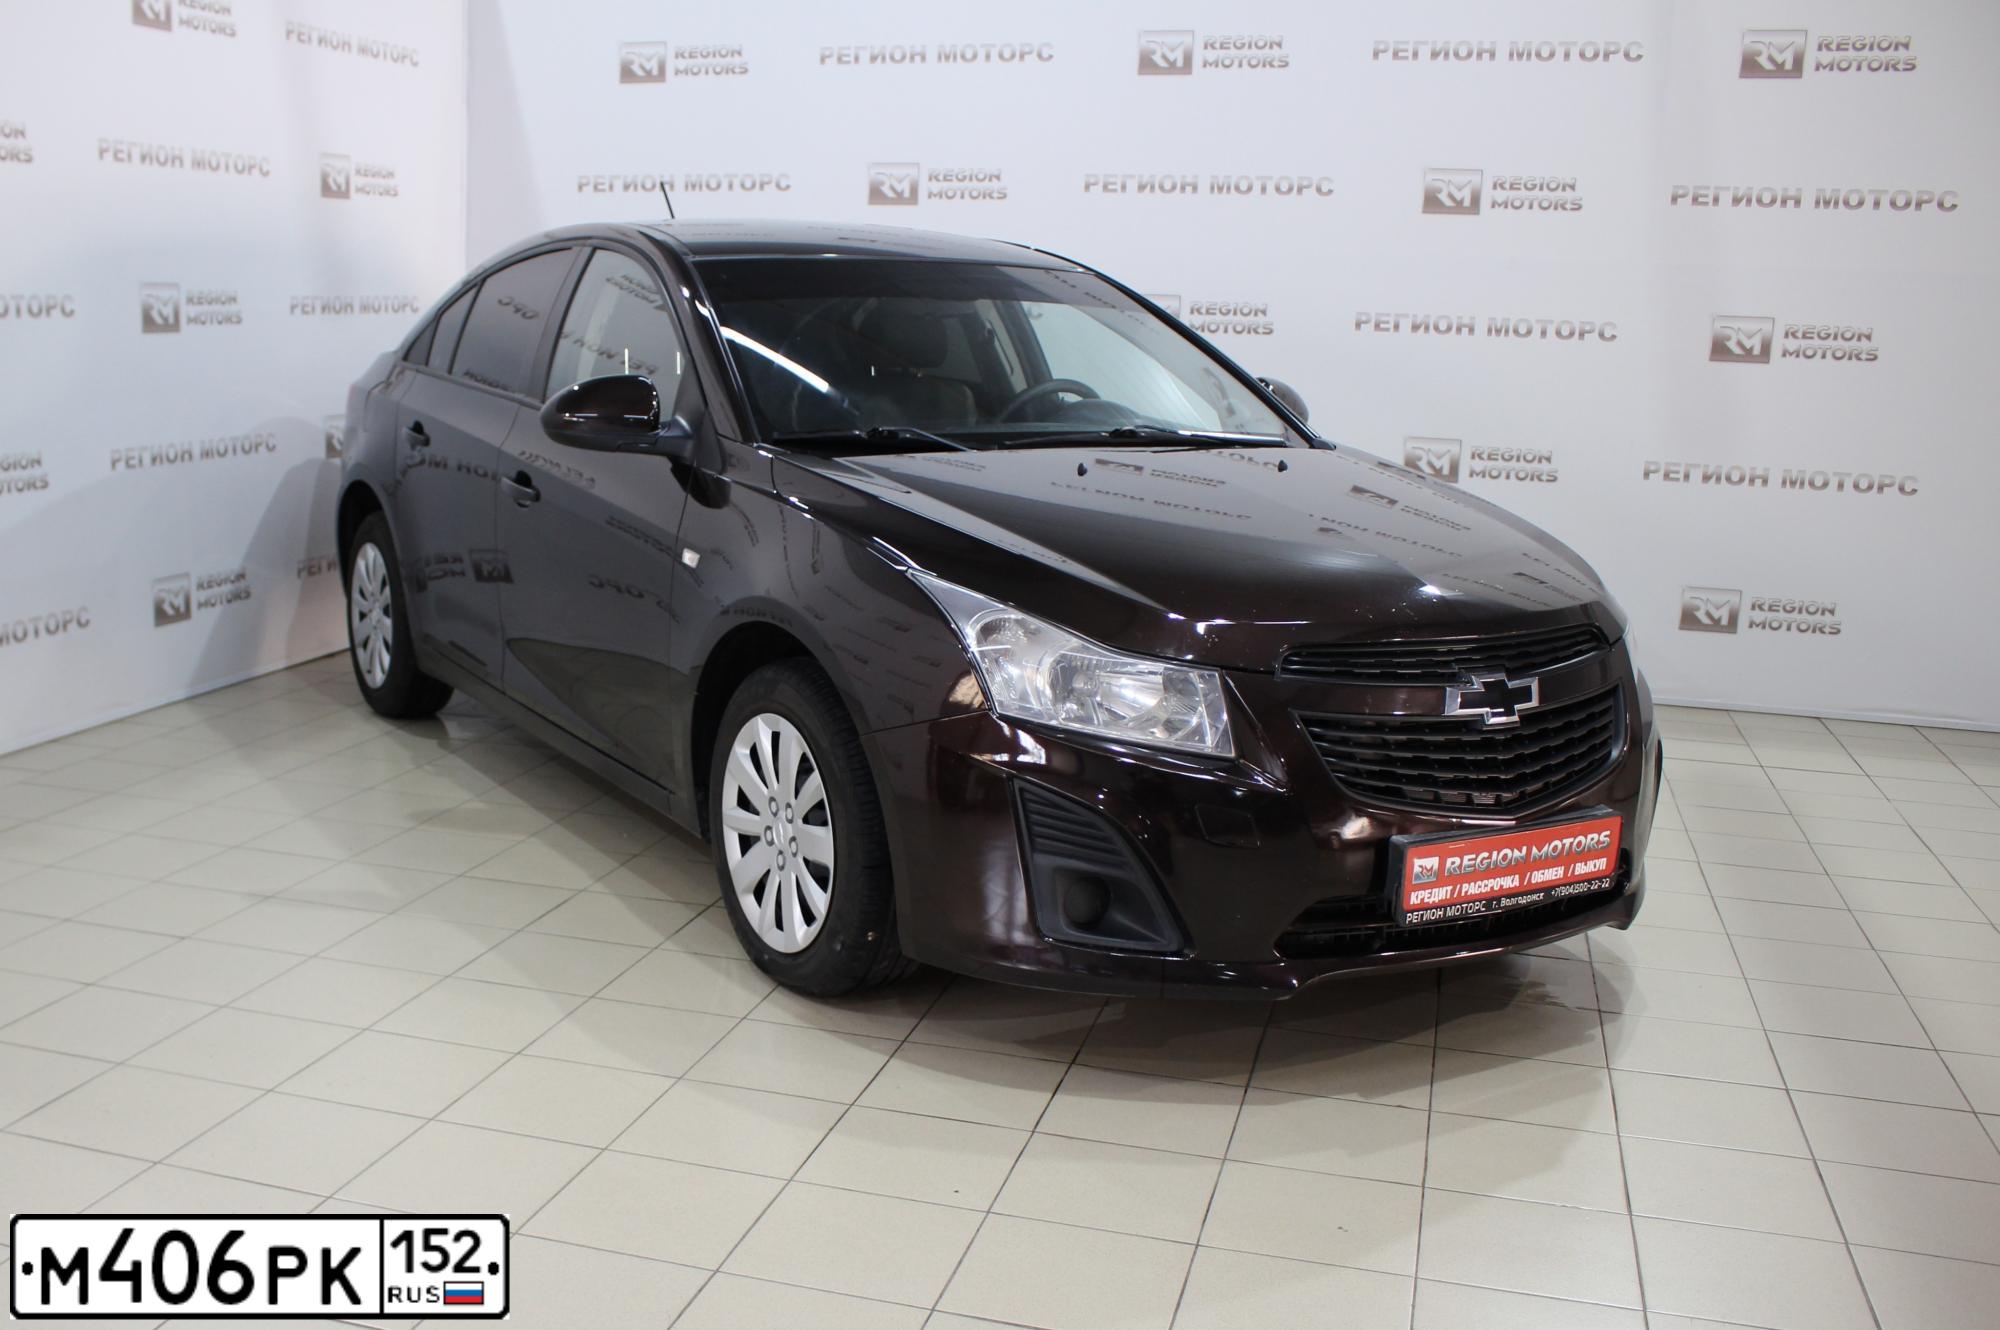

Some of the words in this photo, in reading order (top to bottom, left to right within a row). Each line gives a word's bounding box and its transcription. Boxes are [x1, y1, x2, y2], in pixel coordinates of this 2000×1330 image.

[179, 16, 237, 37] MOTORS
[285, 20, 352, 54] РЕГИОН
[357, 36, 420, 67] МОТОРС
[1203, 35, 1283, 51] REGION
[1372, 40, 1496, 62] РЕГИОН
[1508, 40, 1644, 63] МОТОРС
[1816, 35, 1911, 53] REGION
[674, 45, 743, 60] REGION
[819, 45, 926, 66] РЕГИОН
[936, 42, 1054, 63] МОТОРС
[1202, 54, 1290, 69] MOTORS
[674, 62, 749, 77] MOTORS
[1814, 56, 1917, 73] MOTORS
[98, 138, 184, 169] РЕГИОН
[191, 148, 270, 177] МОТОРС
[577, 174, 675, 193] РЕГИОН
[684, 173, 792, 193] МОТОРС
[928, 167, 1001, 183] REGION
[1493, 175, 1576, 192] REGION
[927, 185, 1007, 200] MOTORS
[1084, 173, 1199, 195] РЕГИОН
[1209, 175, 1335, 197] МОТОРС
[1491, 194, 1583, 211] MOTORS
[1670, 185, 1803, 210] РЕГИОН
[1814, 188, 1959, 213] МОТОРС
[186, 290, 238, 306] REGION
[290, 296, 354, 315] РЕГИОН
[360, 295, 420, 314] МОТОРС
[186, 309, 243, 326] MOTORS
[1190, 302, 1268, 317] REGION
[1354, 311, 1476, 337] РЕГИОН
[1486, 315, 1618, 343] МОТОРС
[1783, 324, 1873, 343] REGION
[1780, 345, 1880, 363] MOTORS
[111, 442, 193, 471] РЕГИОН
[201, 433, 277, 461] МОТОРС
[1471, 446, 1553, 464] REGION
[1468, 467, 1559, 484] MOTORS
[1642, 460, 1770, 489] РЕГИОН
[1780, 468, 1919, 497] МОТОРС
[1751, 598, 1836, 616] REGION
[1747, 618, 1842, 635] MOTORS
[1445, 846, 1527, 876] REGION
[1531, 831, 1610, 861] MOTORS
[1410, 886, 1453, 905] КРЕДИТ
[1406, 908, 1444, 924] РЕГИОН
[1446, 901, 1486, 917] МОТОРС
[1500, 892, 1544, 907] Волгодонск
